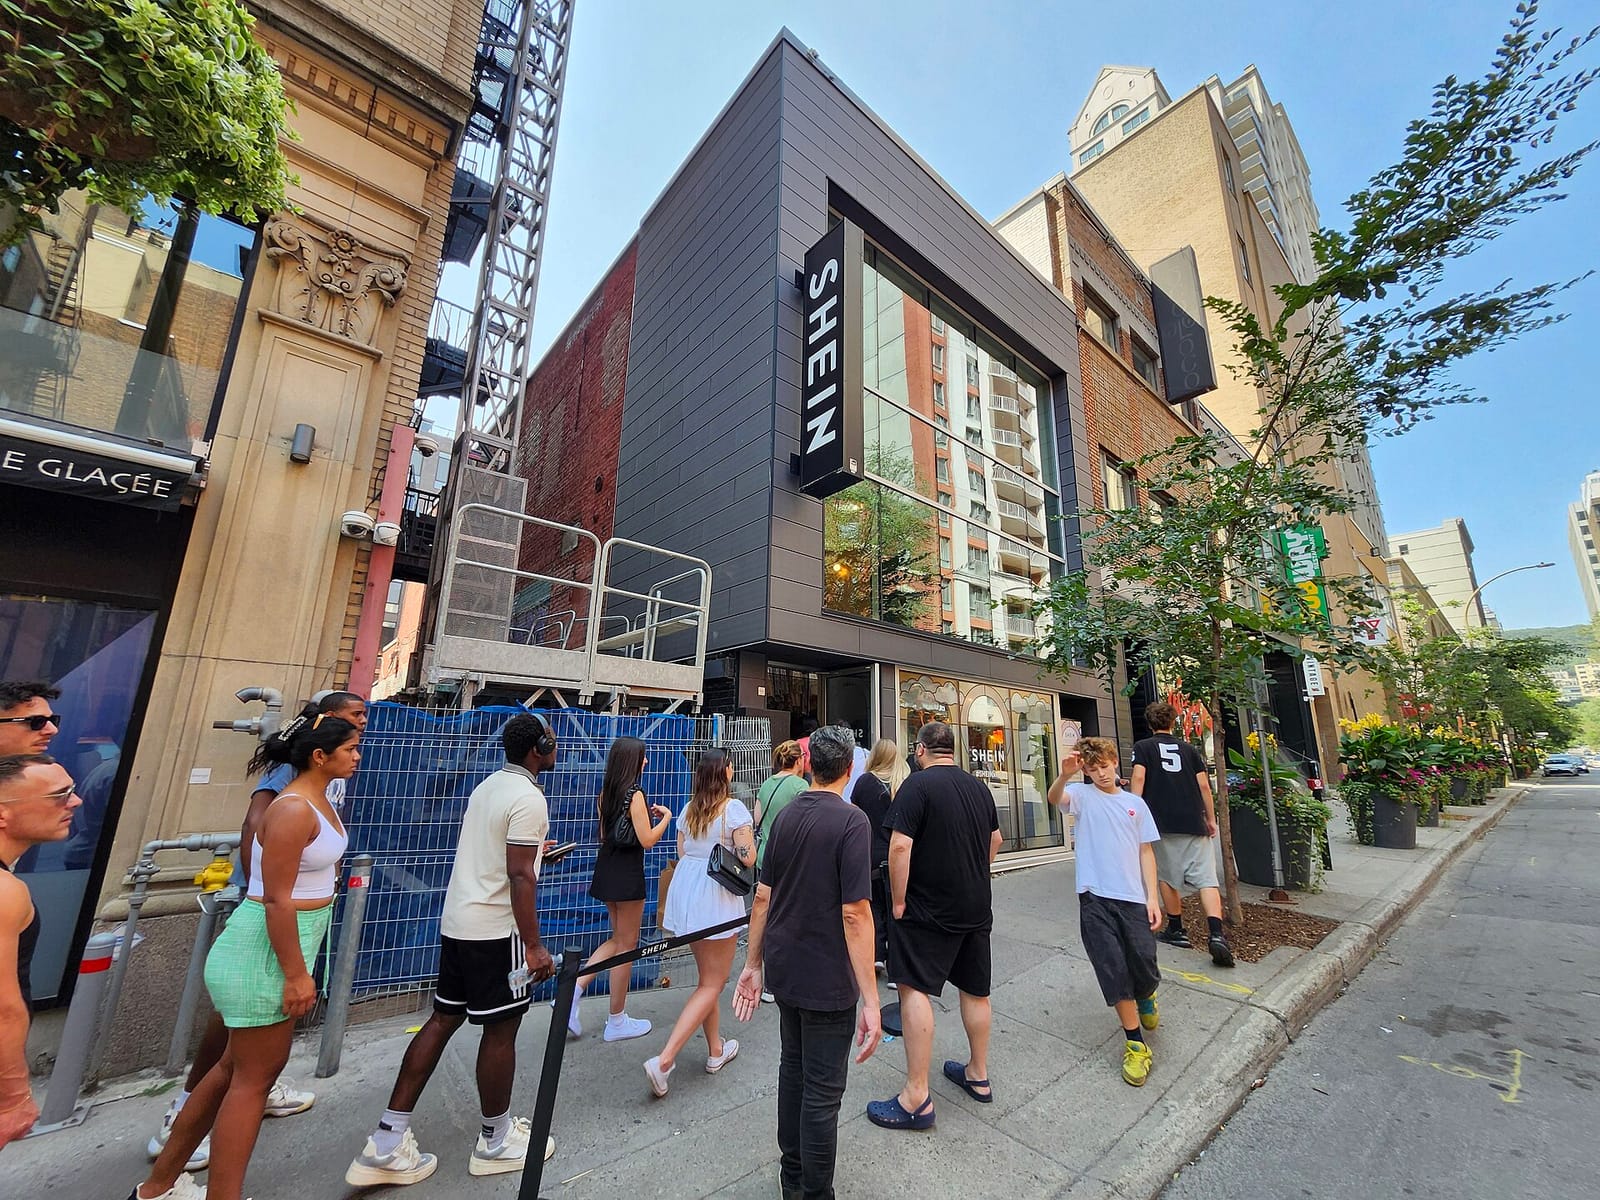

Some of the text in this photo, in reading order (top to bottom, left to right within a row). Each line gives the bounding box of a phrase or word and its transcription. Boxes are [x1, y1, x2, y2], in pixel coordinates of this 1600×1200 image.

[806, 258, 838, 455] SHEIN
[3, 450, 173, 498] E GLAÇÉE
[1284, 528, 1322, 619] UBWAY
[971, 749, 1005, 763] SHEIN
[1158, 742, 1183, 773] 5
[641, 942, 669, 957] SHEIN
